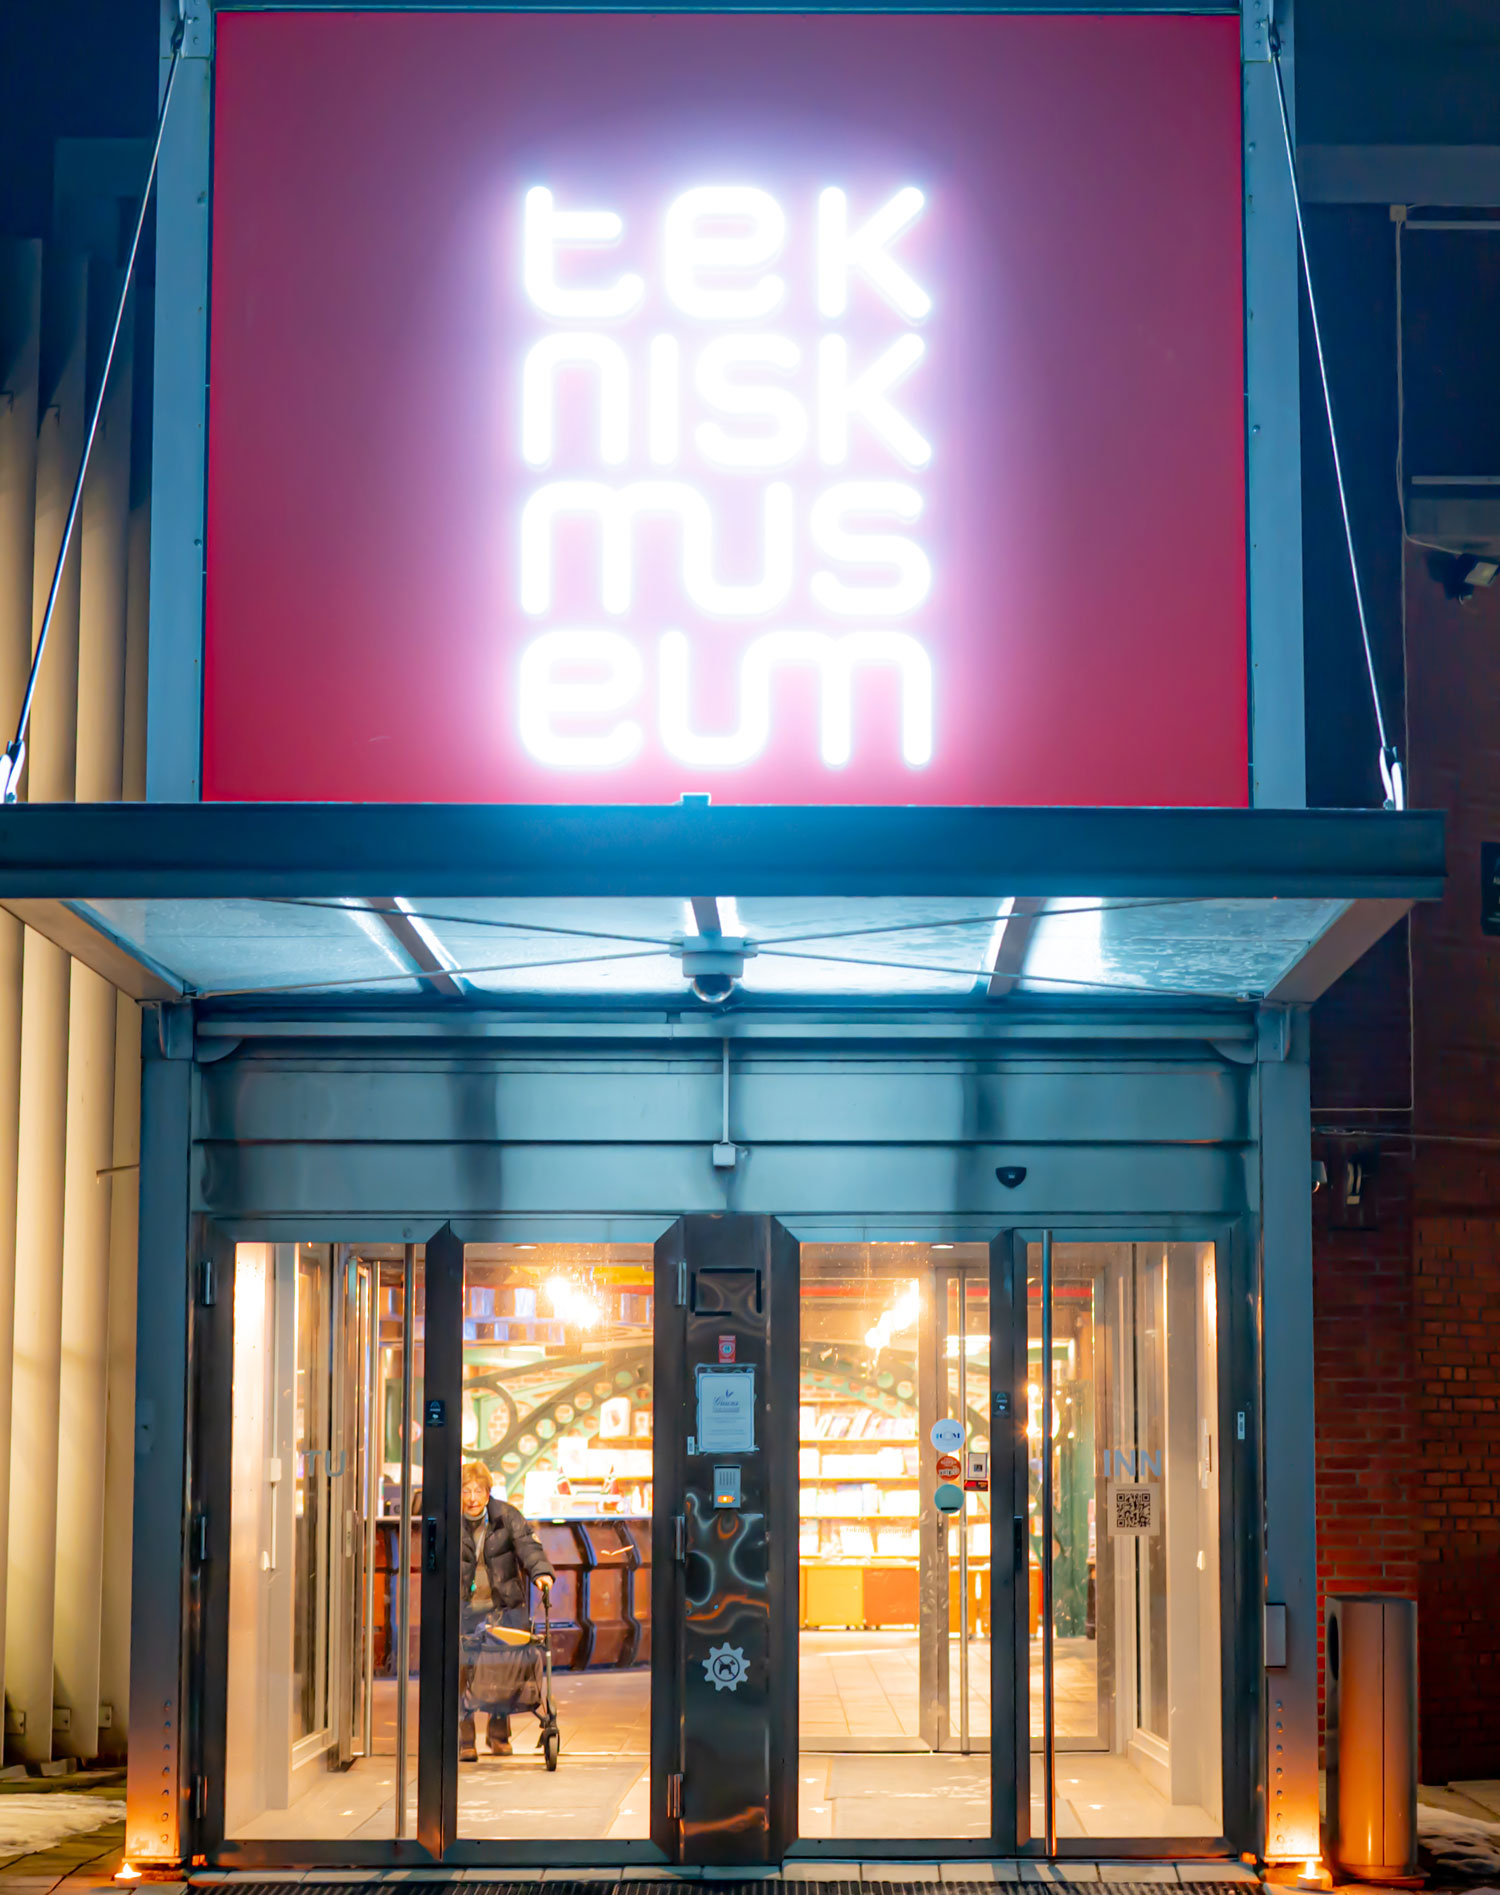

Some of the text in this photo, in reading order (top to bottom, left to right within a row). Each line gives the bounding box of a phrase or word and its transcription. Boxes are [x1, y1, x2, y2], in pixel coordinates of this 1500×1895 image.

[522, 185, 932, 323] tek
[521, 332, 932, 468] nisk
[520, 480, 932, 617] mus
[518, 629, 933, 769] eum
[1103, 1449, 1161, 1477] INN
